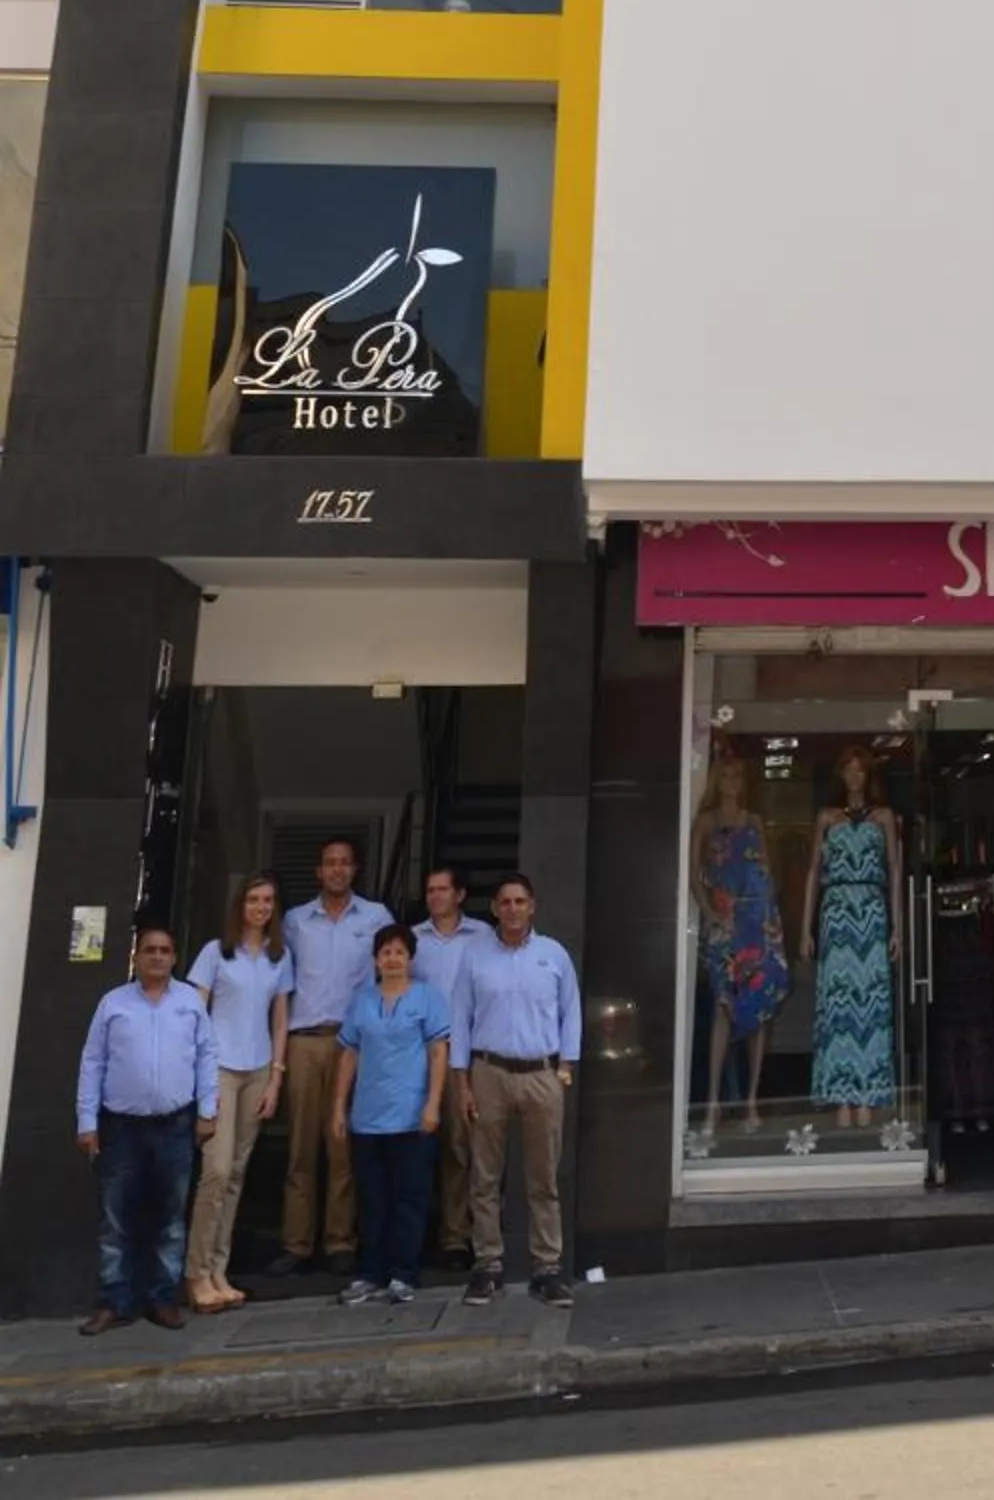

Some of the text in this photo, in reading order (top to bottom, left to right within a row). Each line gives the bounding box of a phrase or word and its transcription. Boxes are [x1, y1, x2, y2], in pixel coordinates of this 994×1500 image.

[233, 321, 443, 390] La Pera
[293, 397, 393, 429] Hotel
